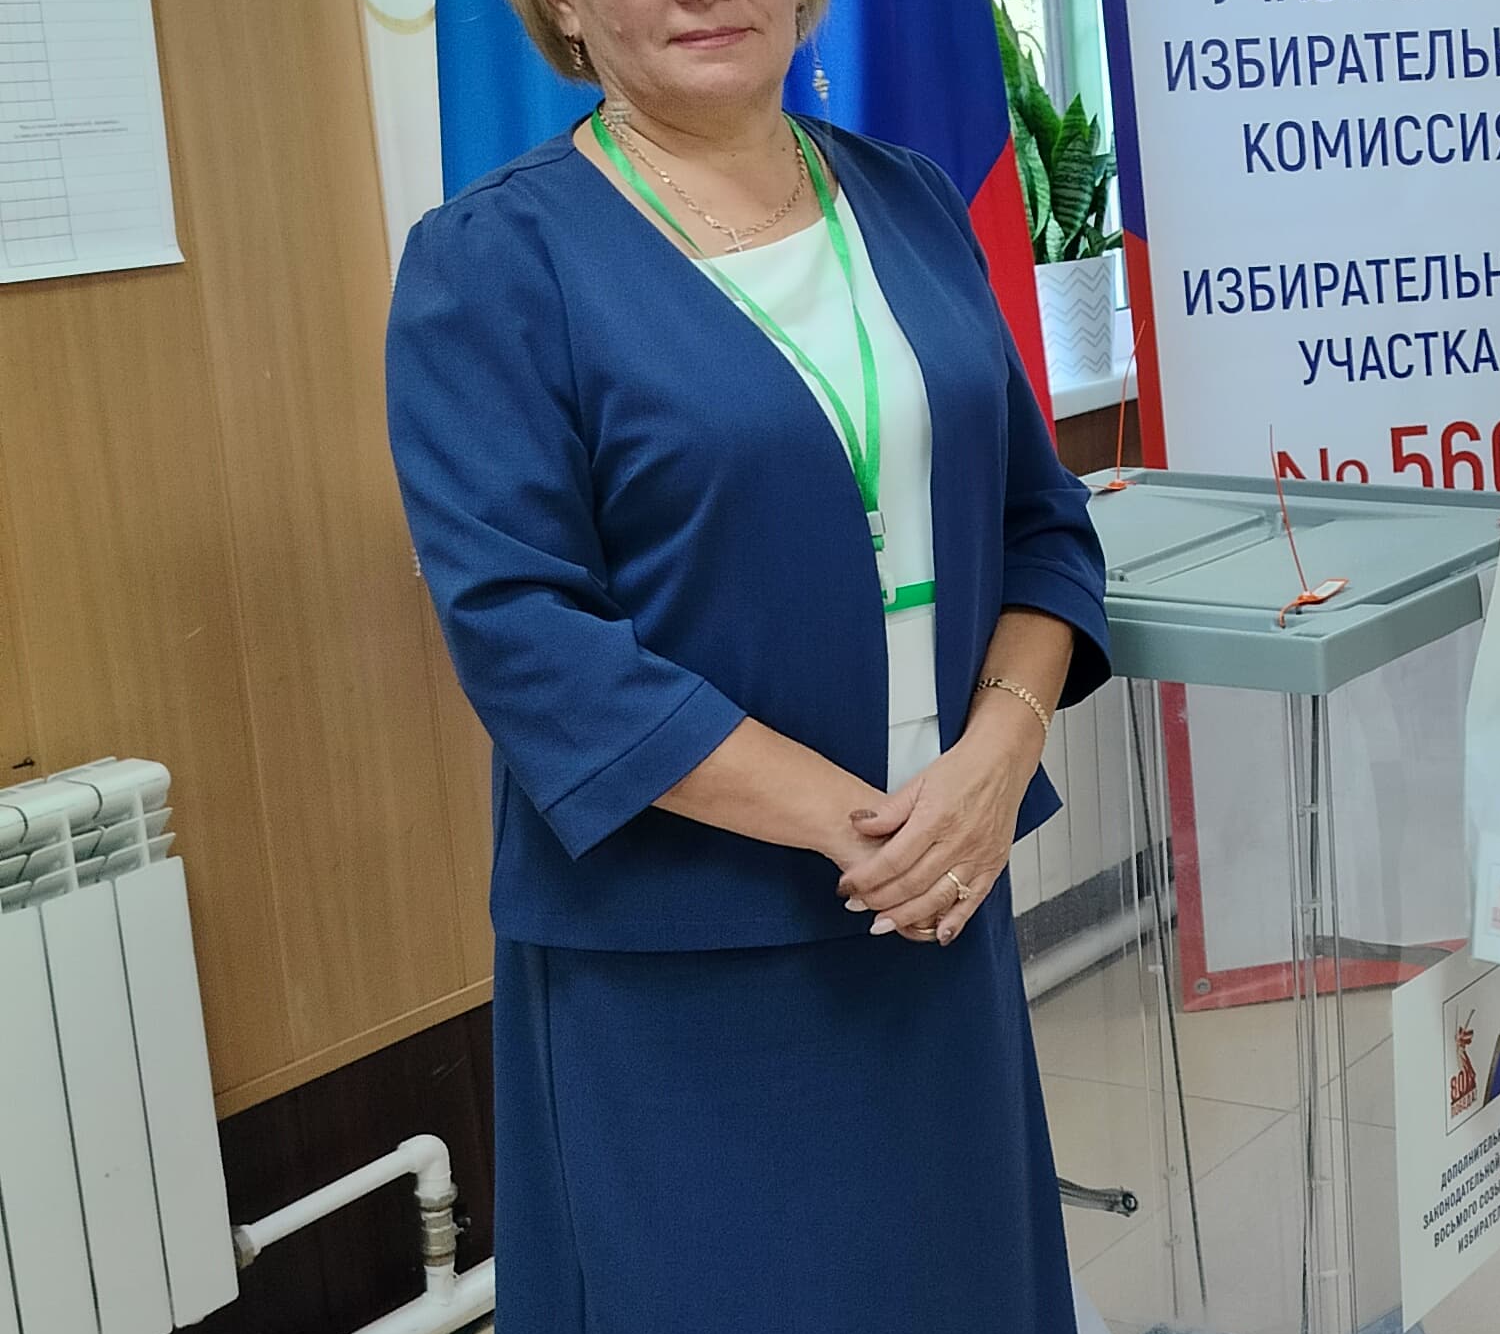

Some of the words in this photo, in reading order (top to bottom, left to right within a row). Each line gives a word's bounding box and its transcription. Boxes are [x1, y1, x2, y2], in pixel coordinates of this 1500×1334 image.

[1298, 327, 1500, 386] УЧАСТКА
[1423, 1151, 1500, 1230] ЗАКОНОДАТЕЛЬНОЙ
[1433, 1199, 1478, 1249] ВОСЬМОГО
